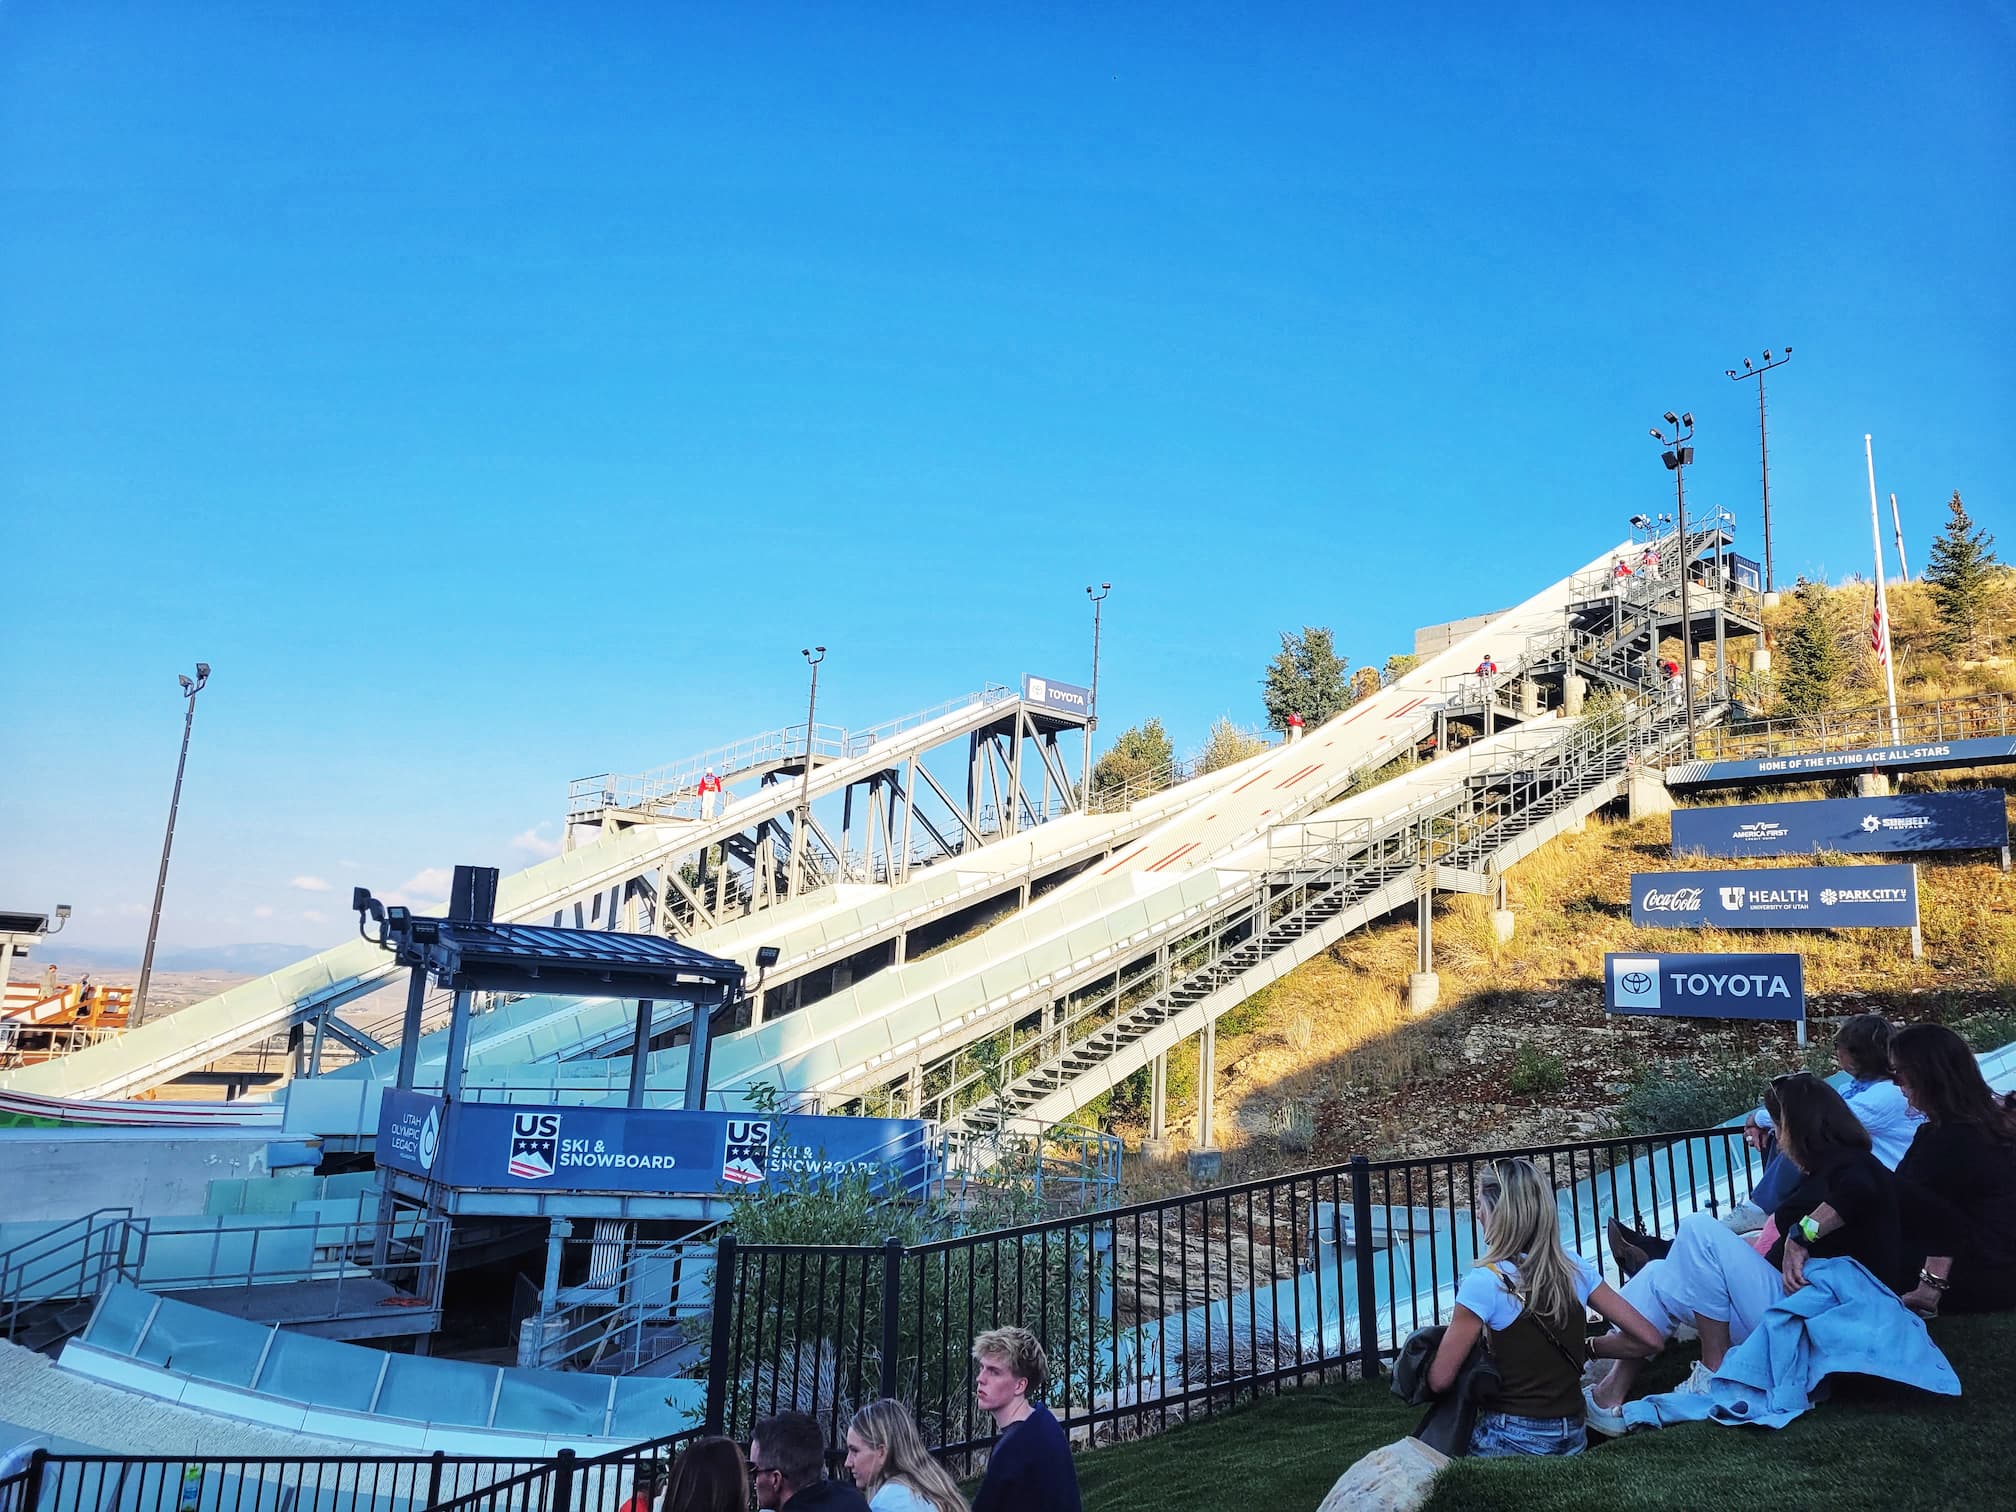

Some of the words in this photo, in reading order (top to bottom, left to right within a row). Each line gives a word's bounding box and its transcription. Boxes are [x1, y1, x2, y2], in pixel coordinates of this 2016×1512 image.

[1048, 688, 1084, 705] TOYOTA
[1759, 761, 1787, 772] HOME
[1788, 760, 1802, 769] OF
[1804, 758, 1824, 768] THE
[1826, 754, 1863, 766] FLYING
[1865, 751, 1887, 763] ACE
[1888, 746, 1950, 760] ALL-STARS
[1732, 830, 1766, 838] AMERICA
[1766, 829, 1789, 837] FIRST
[1749, 889, 1809, 903] HEALTH
[1838, 890, 1872, 900] PARK
[1872, 889, 1900, 899] CITY
[1670, 973, 1791, 998] TOYOTA
[403, 1113, 422, 1127] UTAH
[515, 1115, 558, 1137] US
[391, 1123, 421, 1140] OLYMPIC
[728, 1122, 767, 1144] US
[391, 1137, 418, 1153] LEGACY
[561, 1139, 589, 1153] SKI
[593, 1139, 605, 1153] &
[560, 1153, 676, 1169] SNOWBOARD
